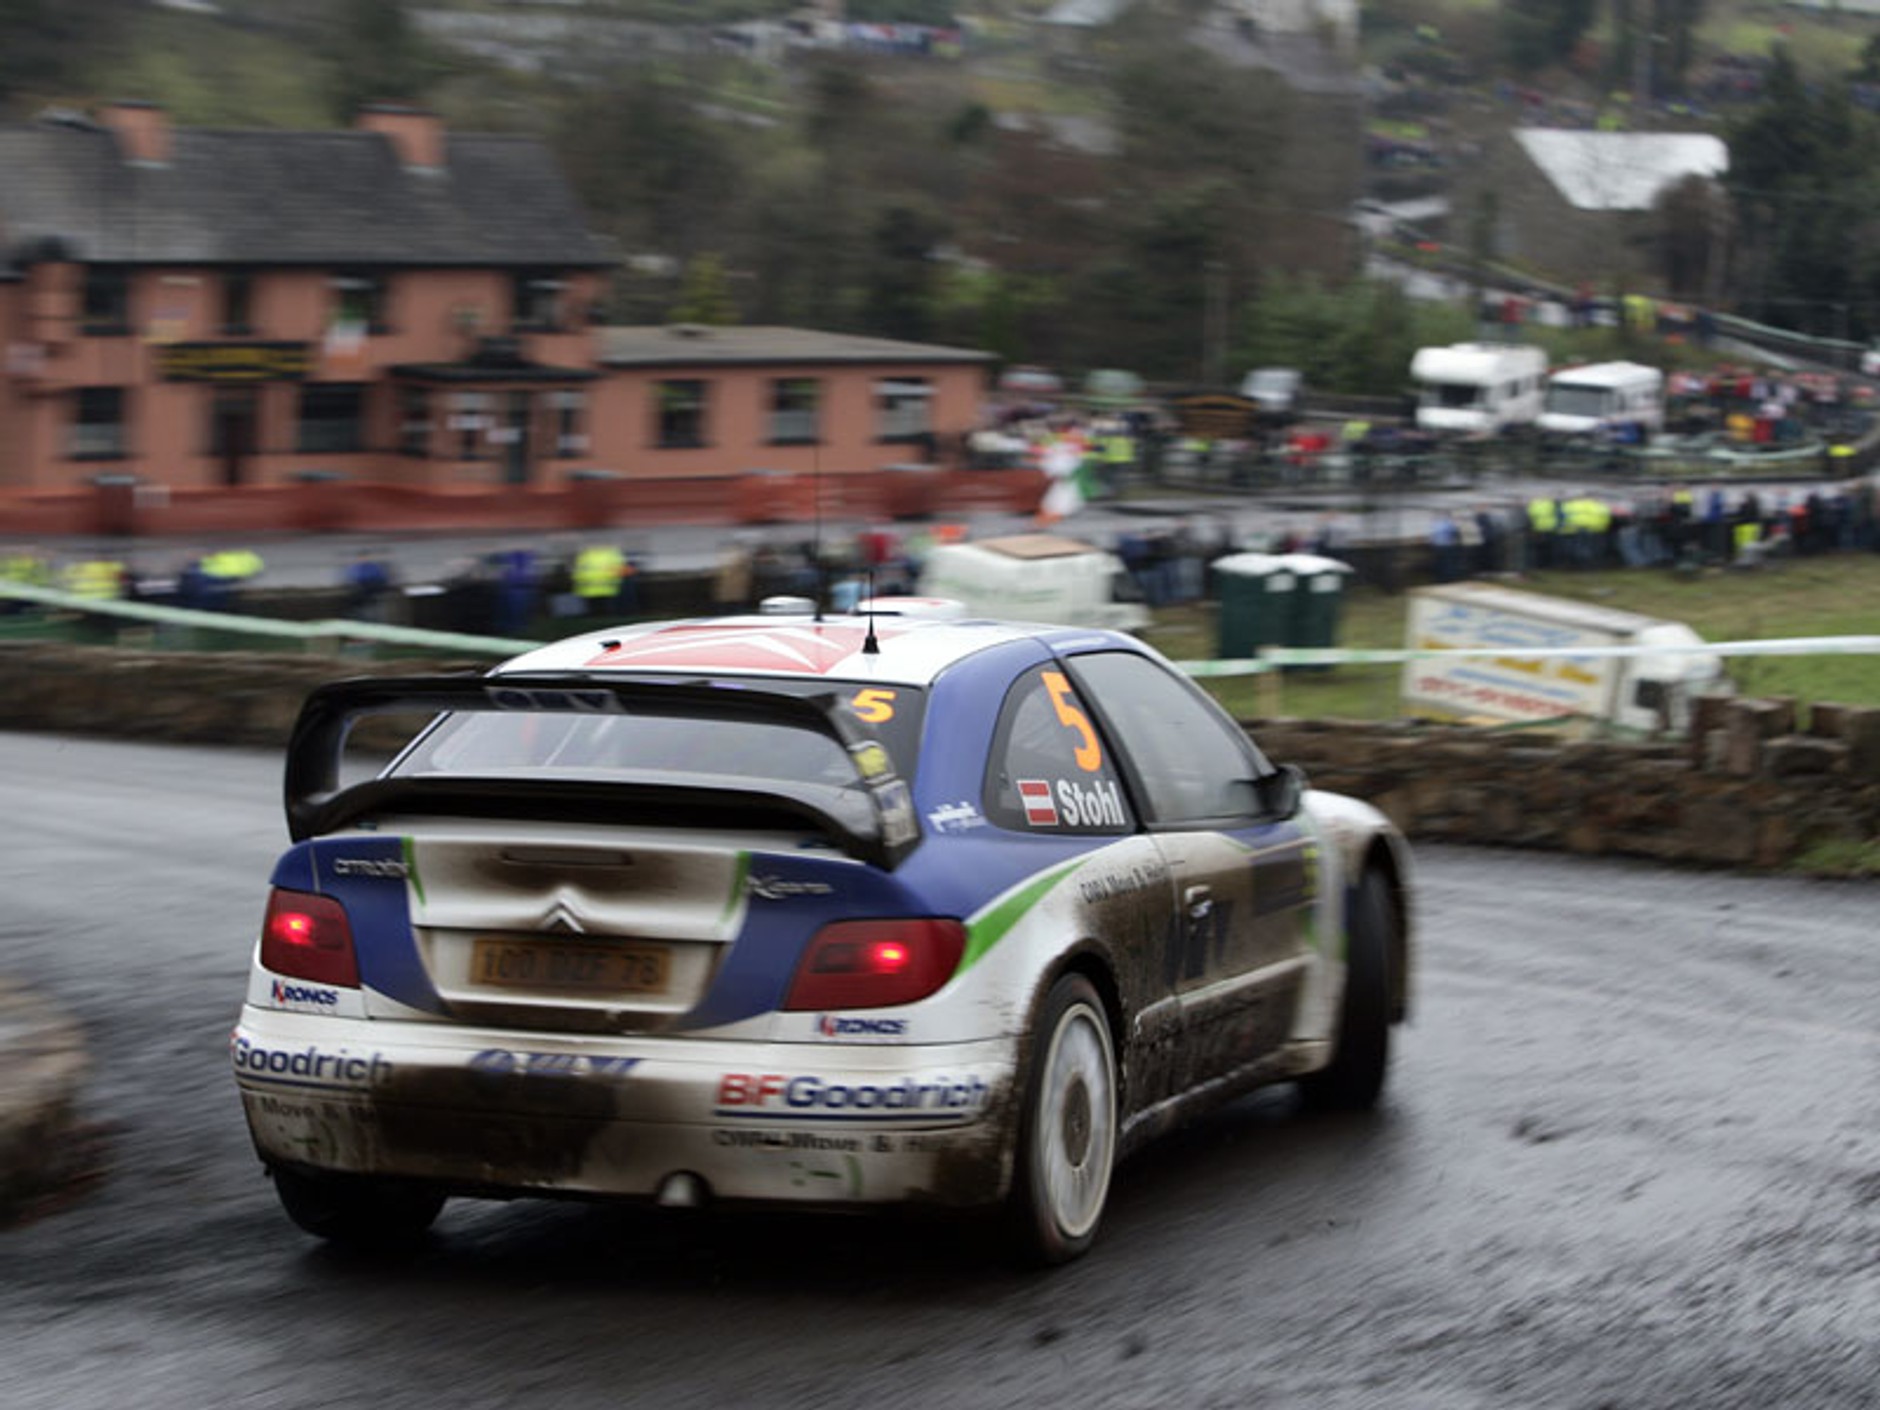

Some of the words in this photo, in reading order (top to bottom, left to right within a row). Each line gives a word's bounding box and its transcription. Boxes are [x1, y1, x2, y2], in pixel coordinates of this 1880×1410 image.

[851, 688, 896, 723] 5
[1041, 671, 1103, 773] 5
[1057, 779, 1126, 826] Stohl
[271, 979, 339, 1006] KRONOS
[814, 1013, 909, 1038] KRONOS
[229, 1032, 394, 1084] Goodrich
[714, 1074, 990, 1109] BFGoodrich
